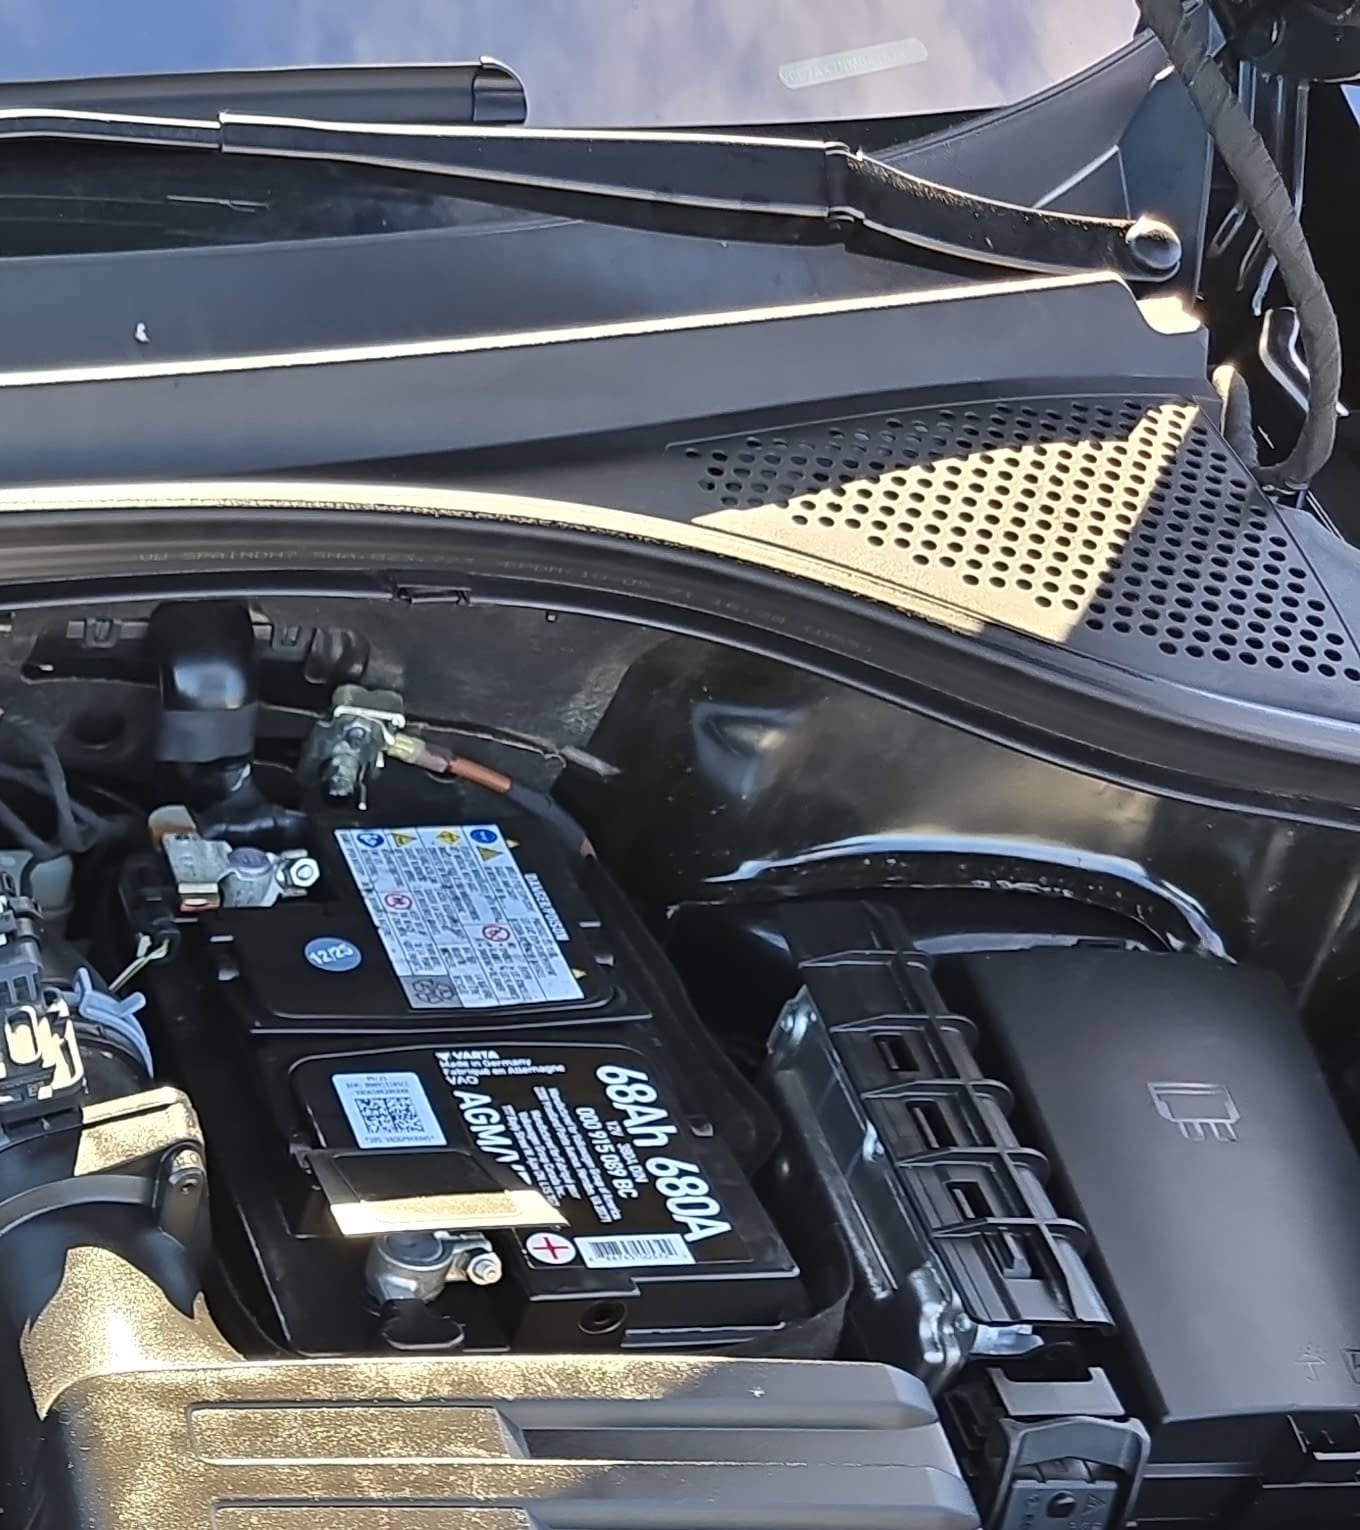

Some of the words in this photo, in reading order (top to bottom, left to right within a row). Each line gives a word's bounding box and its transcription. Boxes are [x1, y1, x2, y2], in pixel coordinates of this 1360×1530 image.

[575, 1106, 603, 1130] 000
[587, 1129, 616, 1153] 915
[596, 1065, 678, 1148] 68Ah
[644, 1156, 733, 1243] 680A
[611, 1178, 639, 1199] BC
